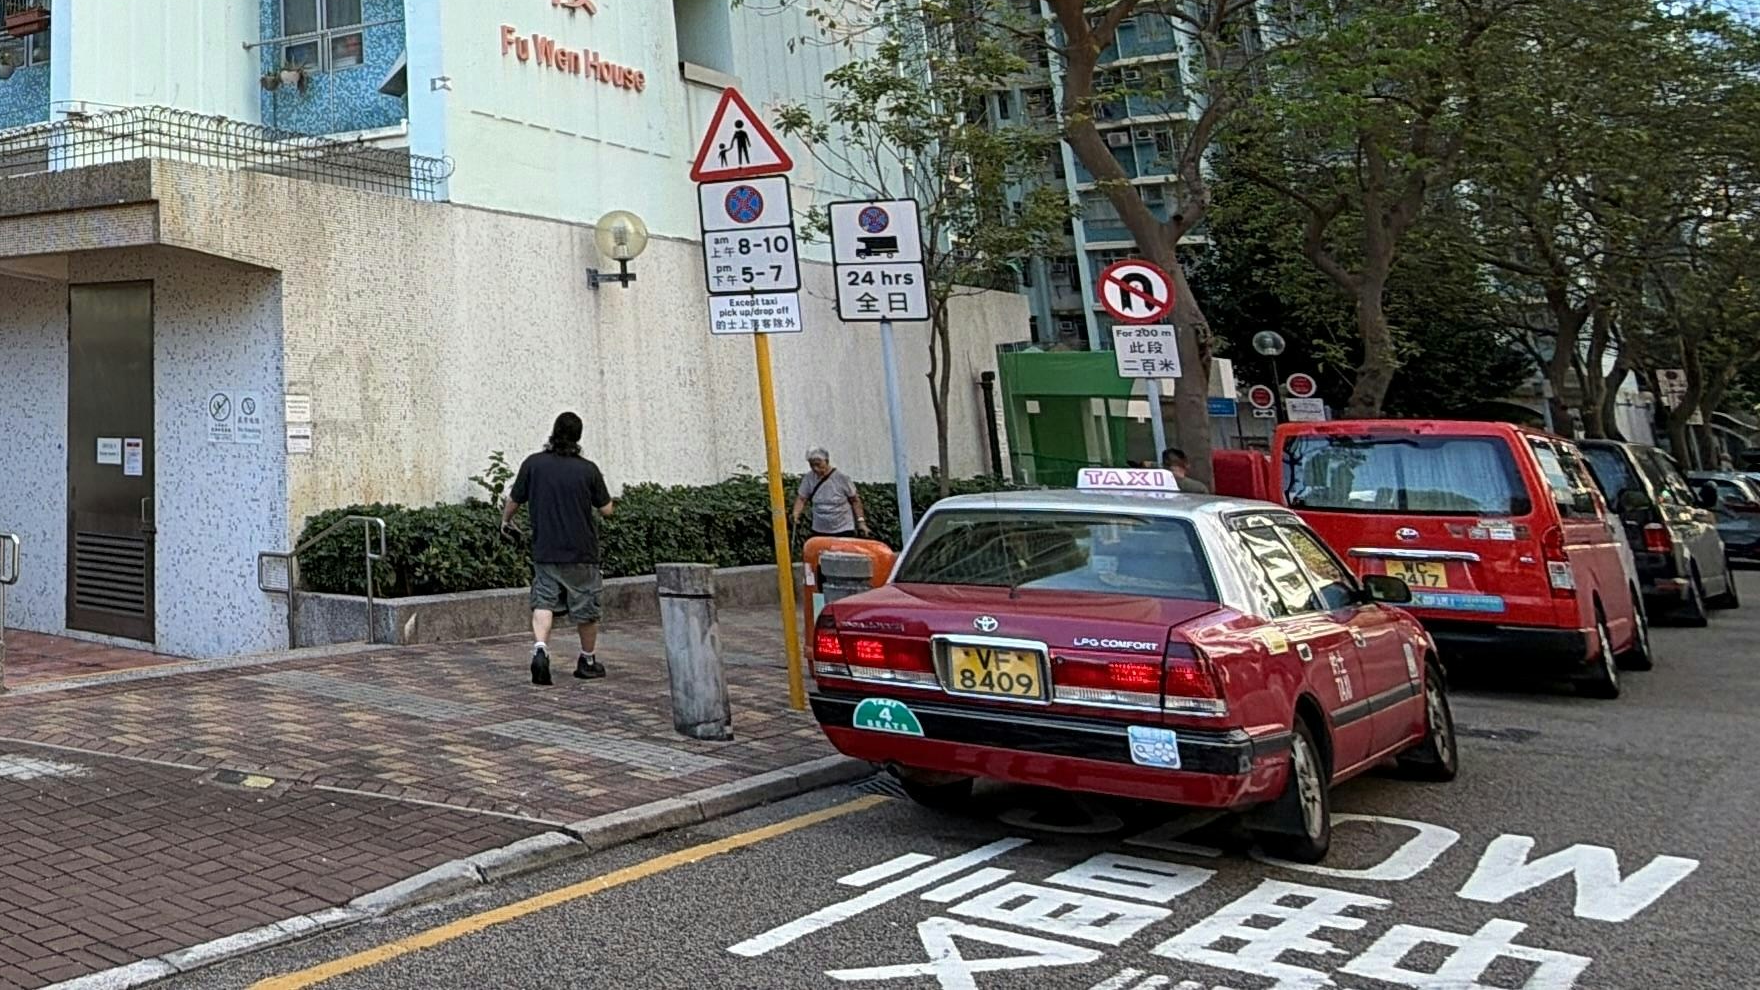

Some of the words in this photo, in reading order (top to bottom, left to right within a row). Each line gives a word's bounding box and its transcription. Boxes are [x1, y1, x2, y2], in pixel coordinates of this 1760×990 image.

[500, 24, 529, 61] Fu
[531, 33, 581, 75] Wen
[583, 48, 647, 93] House
[711, 247, 735, 258] 上午
[714, 237, 729, 245] am
[738, 236, 789, 255] 8-10
[716, 265, 732, 273] pm
[741, 265, 782, 283] 5-7
[847, 271, 875, 286] 24
[881, 271, 914, 286] hrs
[712, 276, 738, 287] 下午
[729, 298, 760, 307] Except
[761, 298, 778, 306] taxi
[856, 291, 908, 313] 全日
[719, 308, 738, 318] pick
[740, 307, 775, 317] up/drop
[776, 307, 789, 315] off
[1116, 329, 1132, 338] For
[1135, 328, 1158, 338] 200
[1129, 341, 1163, 354] 此段
[1123, 358, 1175, 372] 二百米
[1084, 470, 1165, 487] TAXI
[1402, 560, 1428, 574] WC
[1073, 637, 1099, 647] LPG
[1100, 638, 1158, 651] COMFORT
[975, 648, 1011, 671] VF
[960, 668, 1033, 694] 8409
[878, 707, 893, 721] 4
